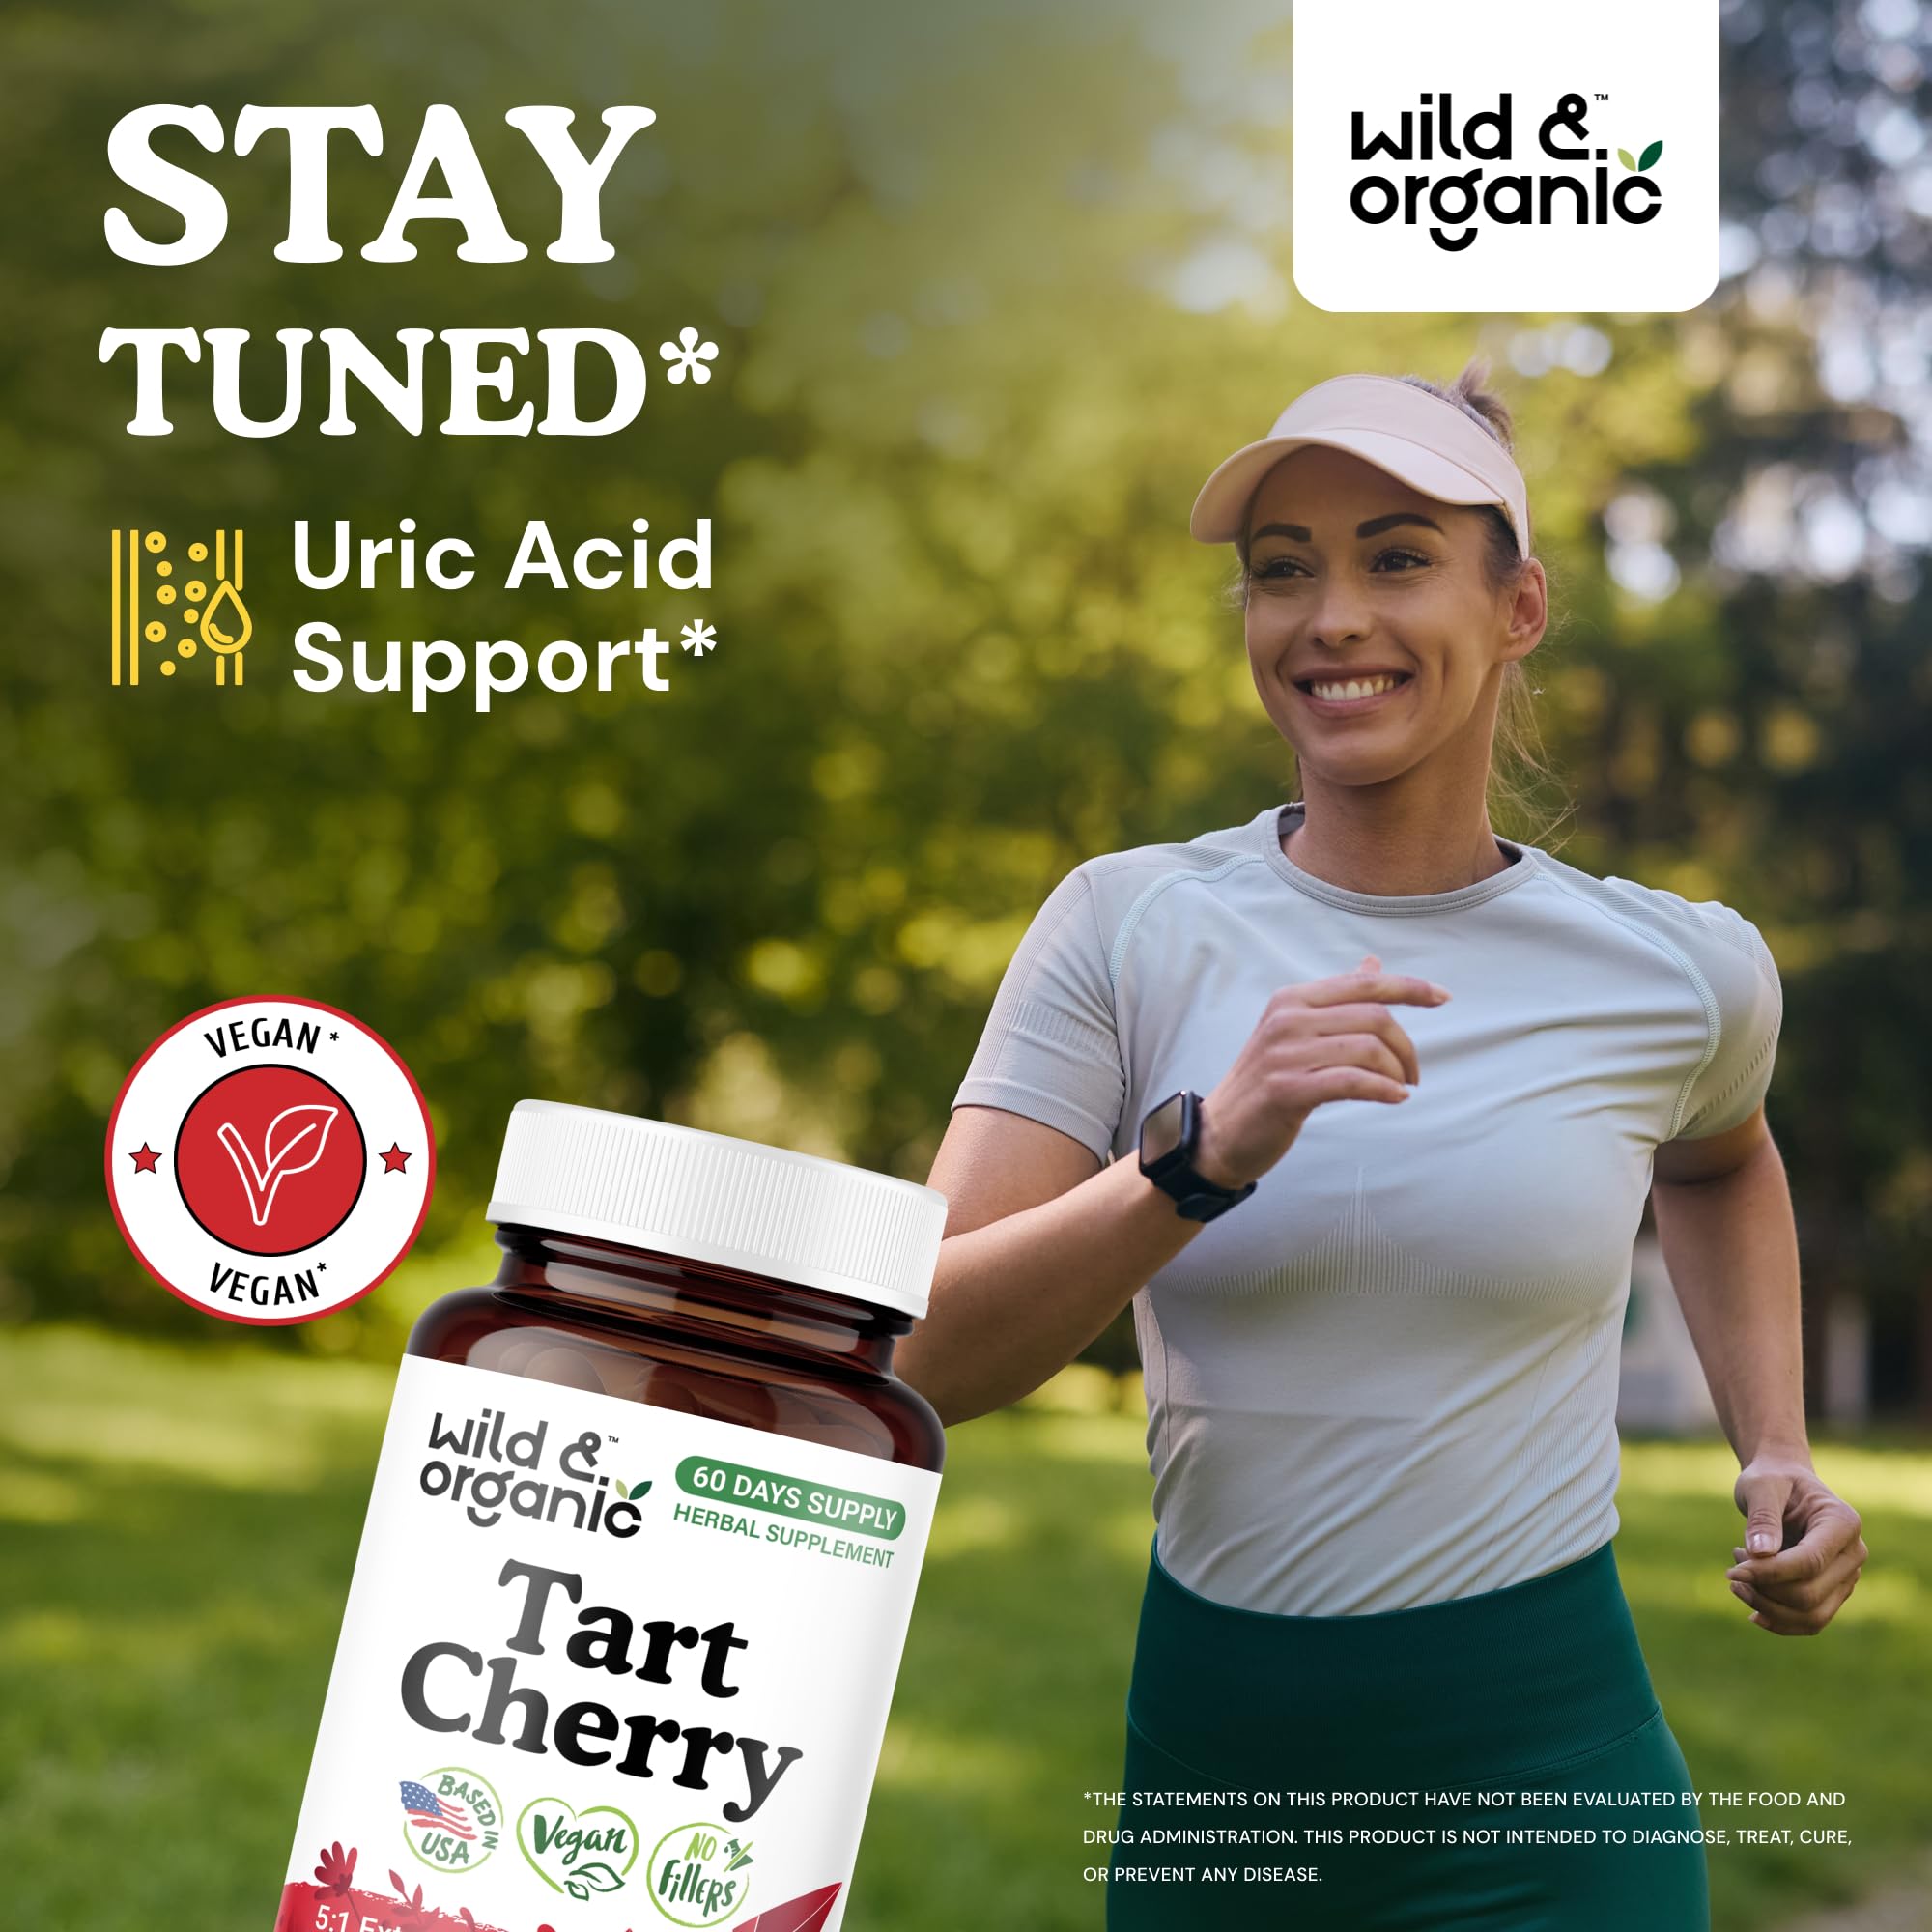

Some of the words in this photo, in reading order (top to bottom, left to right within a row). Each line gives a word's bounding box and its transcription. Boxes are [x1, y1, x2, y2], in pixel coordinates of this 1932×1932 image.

[428, 1408, 549, 1470] wild
[558, 1431, 602, 1483] &
[419, 1460, 642, 1539] organic
[693, 1466, 725, 1492] 60
[732, 1474, 801, 1510] DAYS
[807, 1492, 897, 1531] SUPPLY
[673, 1503, 761, 1539] HERBAL
[765, 1524, 895, 1569] SUPPLEMENT
[498, 1558, 749, 1698] Tart
[400, 1642, 803, 1823] Cherry
[437, 1774, 497, 1827] BASED
[481, 1830, 499, 1850] IN
[533, 1814, 628, 1865] Vegan
[684, 1832, 717, 1861] NO
[420, 1832, 469, 1864] USA
